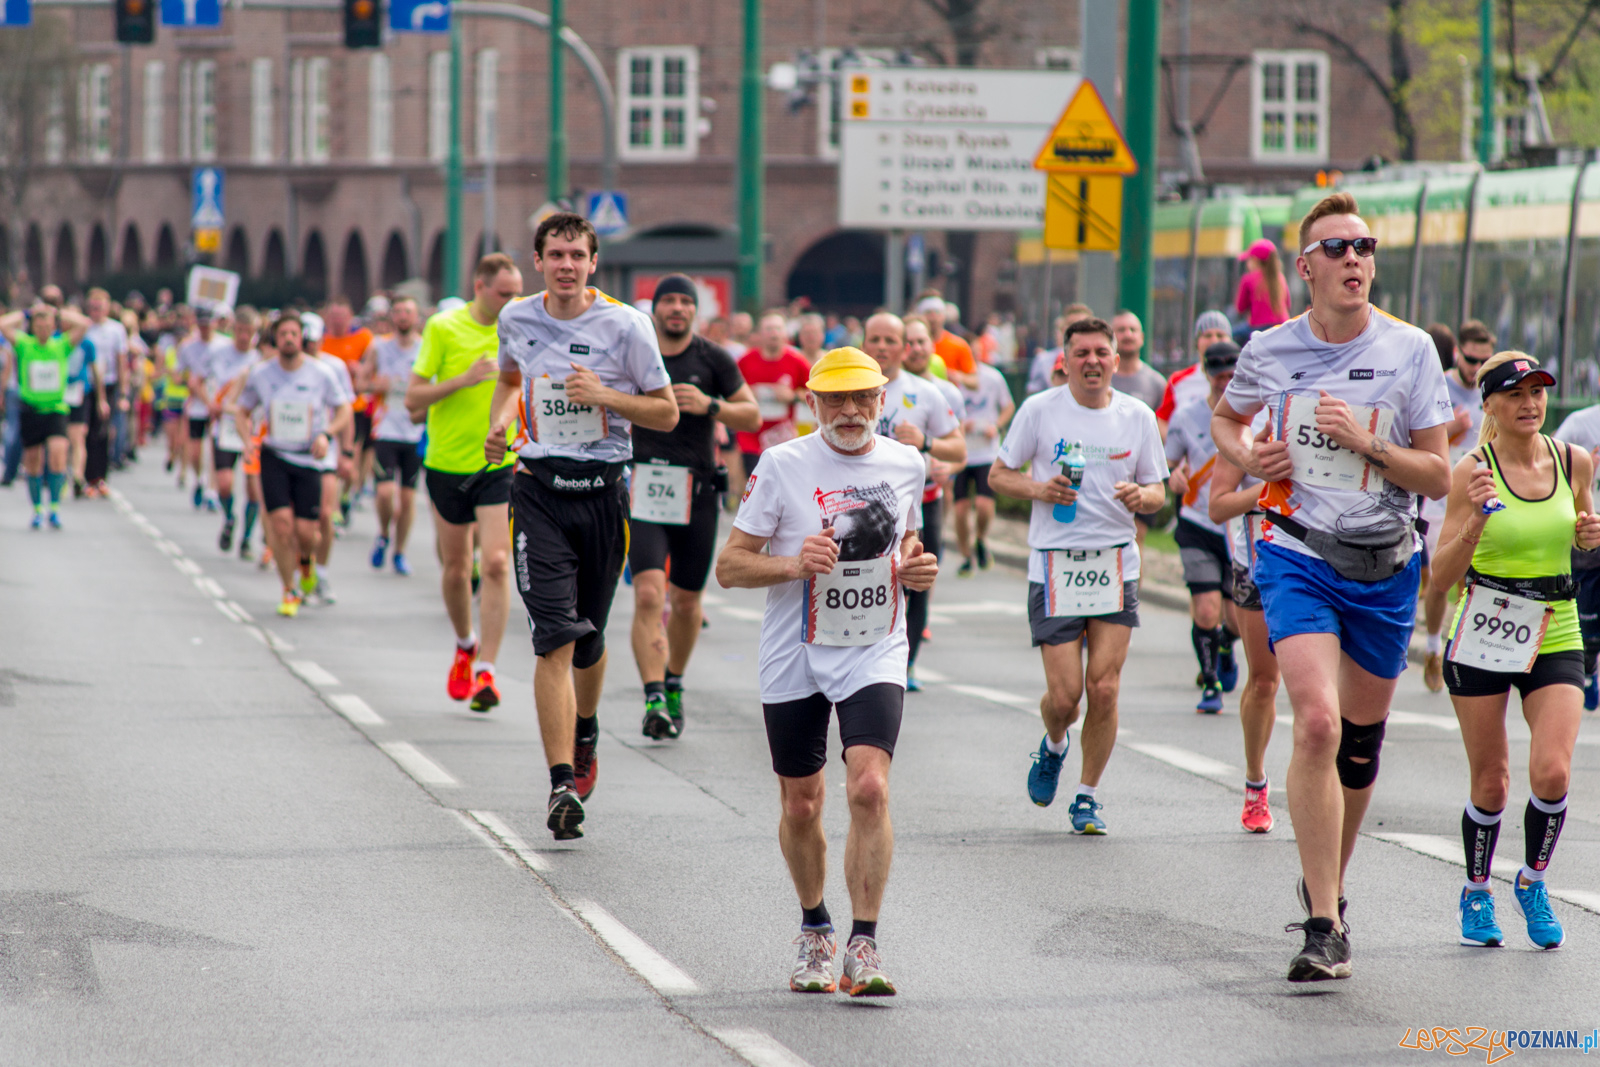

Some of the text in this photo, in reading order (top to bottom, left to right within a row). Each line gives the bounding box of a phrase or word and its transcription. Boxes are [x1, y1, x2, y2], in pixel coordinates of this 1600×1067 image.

[904, 78, 976, 94] Katedra
[904, 100, 987, 122] Cytadela
[957, 131, 1011, 149] Rynek
[542, 399, 592, 416] 3844
[554, 475, 590, 489] Reebok
[648, 483, 675, 498] 574
[1063, 570, 1110, 587] 7696
[826, 585, 887, 610] 8088
[1473, 613, 1531, 644] 9990
